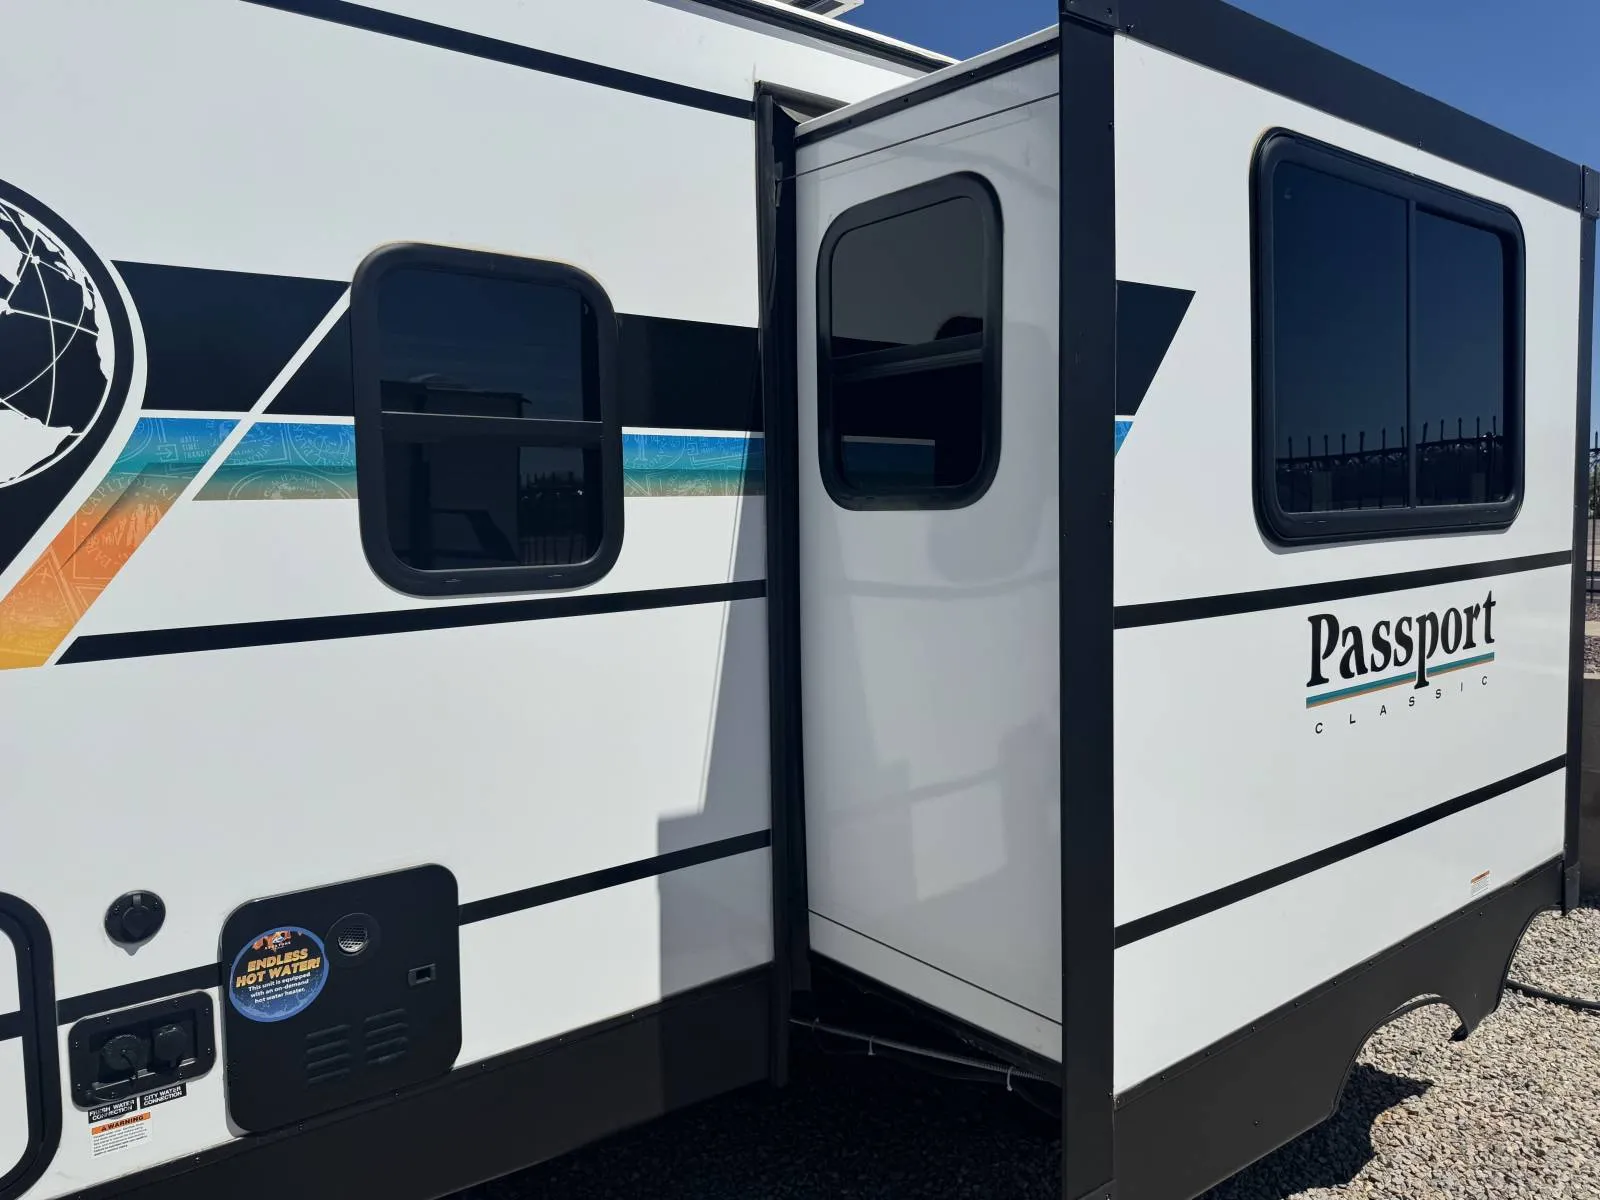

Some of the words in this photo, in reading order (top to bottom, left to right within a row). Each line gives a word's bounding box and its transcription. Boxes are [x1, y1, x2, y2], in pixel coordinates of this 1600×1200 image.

[1306, 590, 1497, 690] Passport
[1315, 675, 1488, 734] CLASSIC
[248, 948, 308, 972] ENDLESS
[236, 971, 266, 988] HOT
[269, 957, 321, 979] WATER!
[248, 983, 261, 992] This
[262, 980, 275, 989] unit
[281, 972, 311, 985] equipped
[250, 990, 265, 998] with
[274, 979, 309, 992] on-demand
[254, 996, 266, 1004] hot
[266, 992, 284, 1001] water
[284, 987, 306, 997] heater.
[143, 1092, 159, 1101] CITY
[159, 1086, 182, 1097] WATER
[143, 1091, 183, 1106] CONNECTION
[89, 1106, 111, 1117] FRESH
[112, 1099, 135, 1110] WATER
[92, 1105, 133, 1121] CONNECTION
[107, 1114, 144, 1129] WARNING
